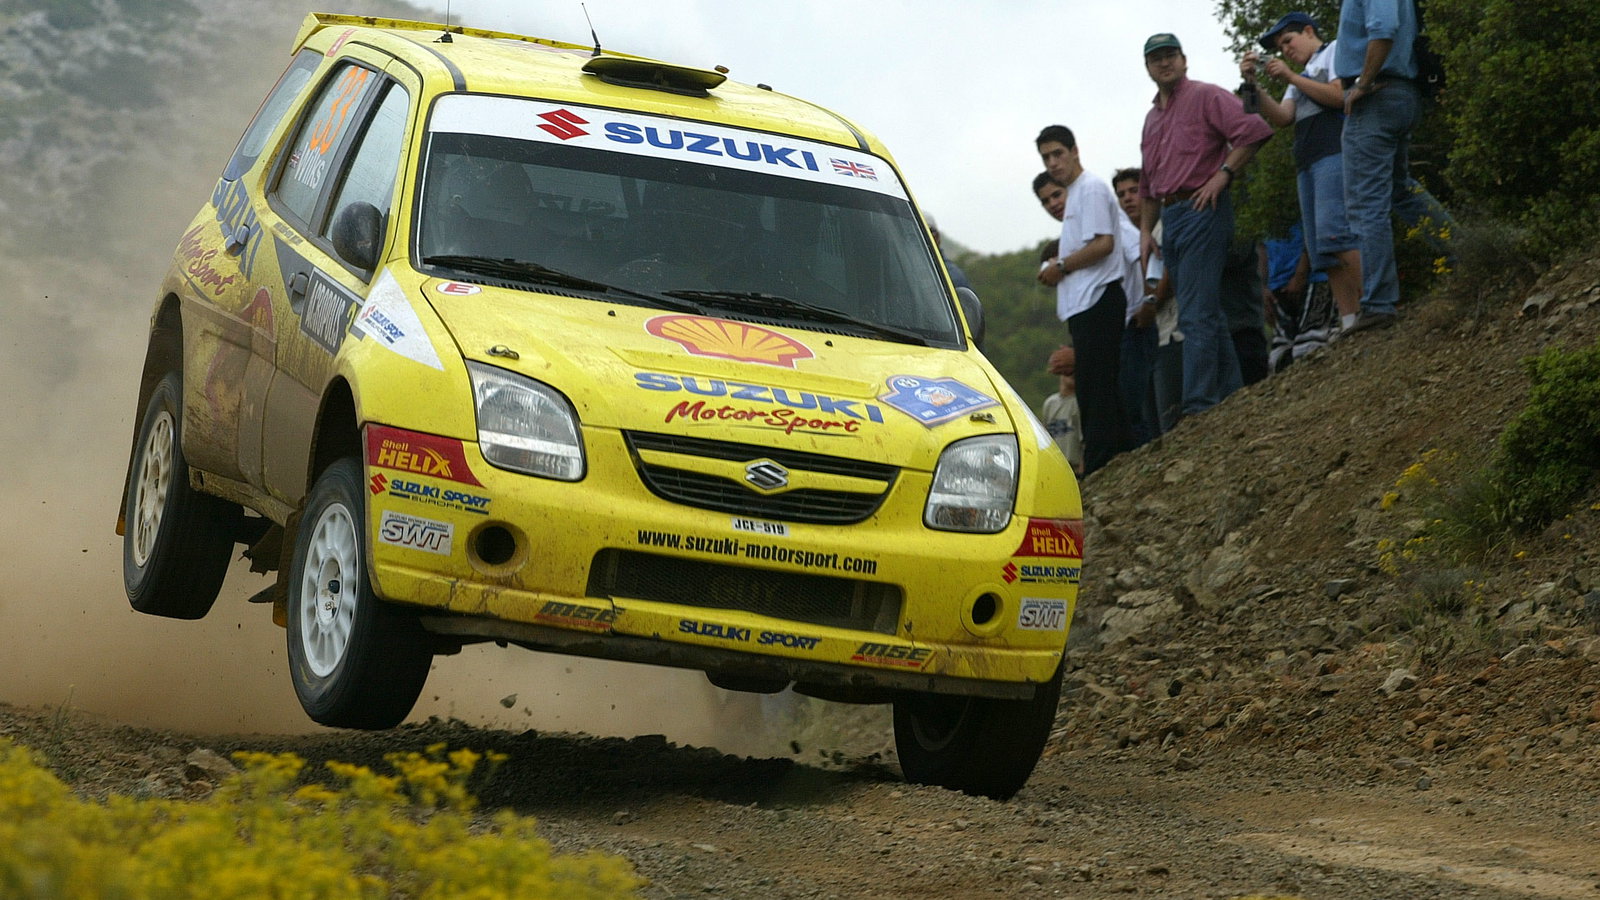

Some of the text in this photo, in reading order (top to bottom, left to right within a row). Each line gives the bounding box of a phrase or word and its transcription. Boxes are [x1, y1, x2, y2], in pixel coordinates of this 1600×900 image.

[310, 65, 368, 155] 33
[604, 121, 820, 172] SUZUKI
[444, 283, 474, 294] E
[634, 372, 884, 424] SUZUKI
[382, 439, 409, 452] Shell
[377, 445, 454, 478] HELIX
[390, 480, 492, 508] SUZUKI SPORT
[382, 519, 449, 551] SWT
[1031, 527, 1051, 537] Shell
[1032, 532, 1080, 556] HELIX
[637, 529, 878, 576] www.suzuki-motorsport.com
[1020, 565, 1081, 579] SUZUKI SPORT
[1020, 604, 1065, 629] SWT
[679, 618, 823, 651] SUZUKI SPORT
